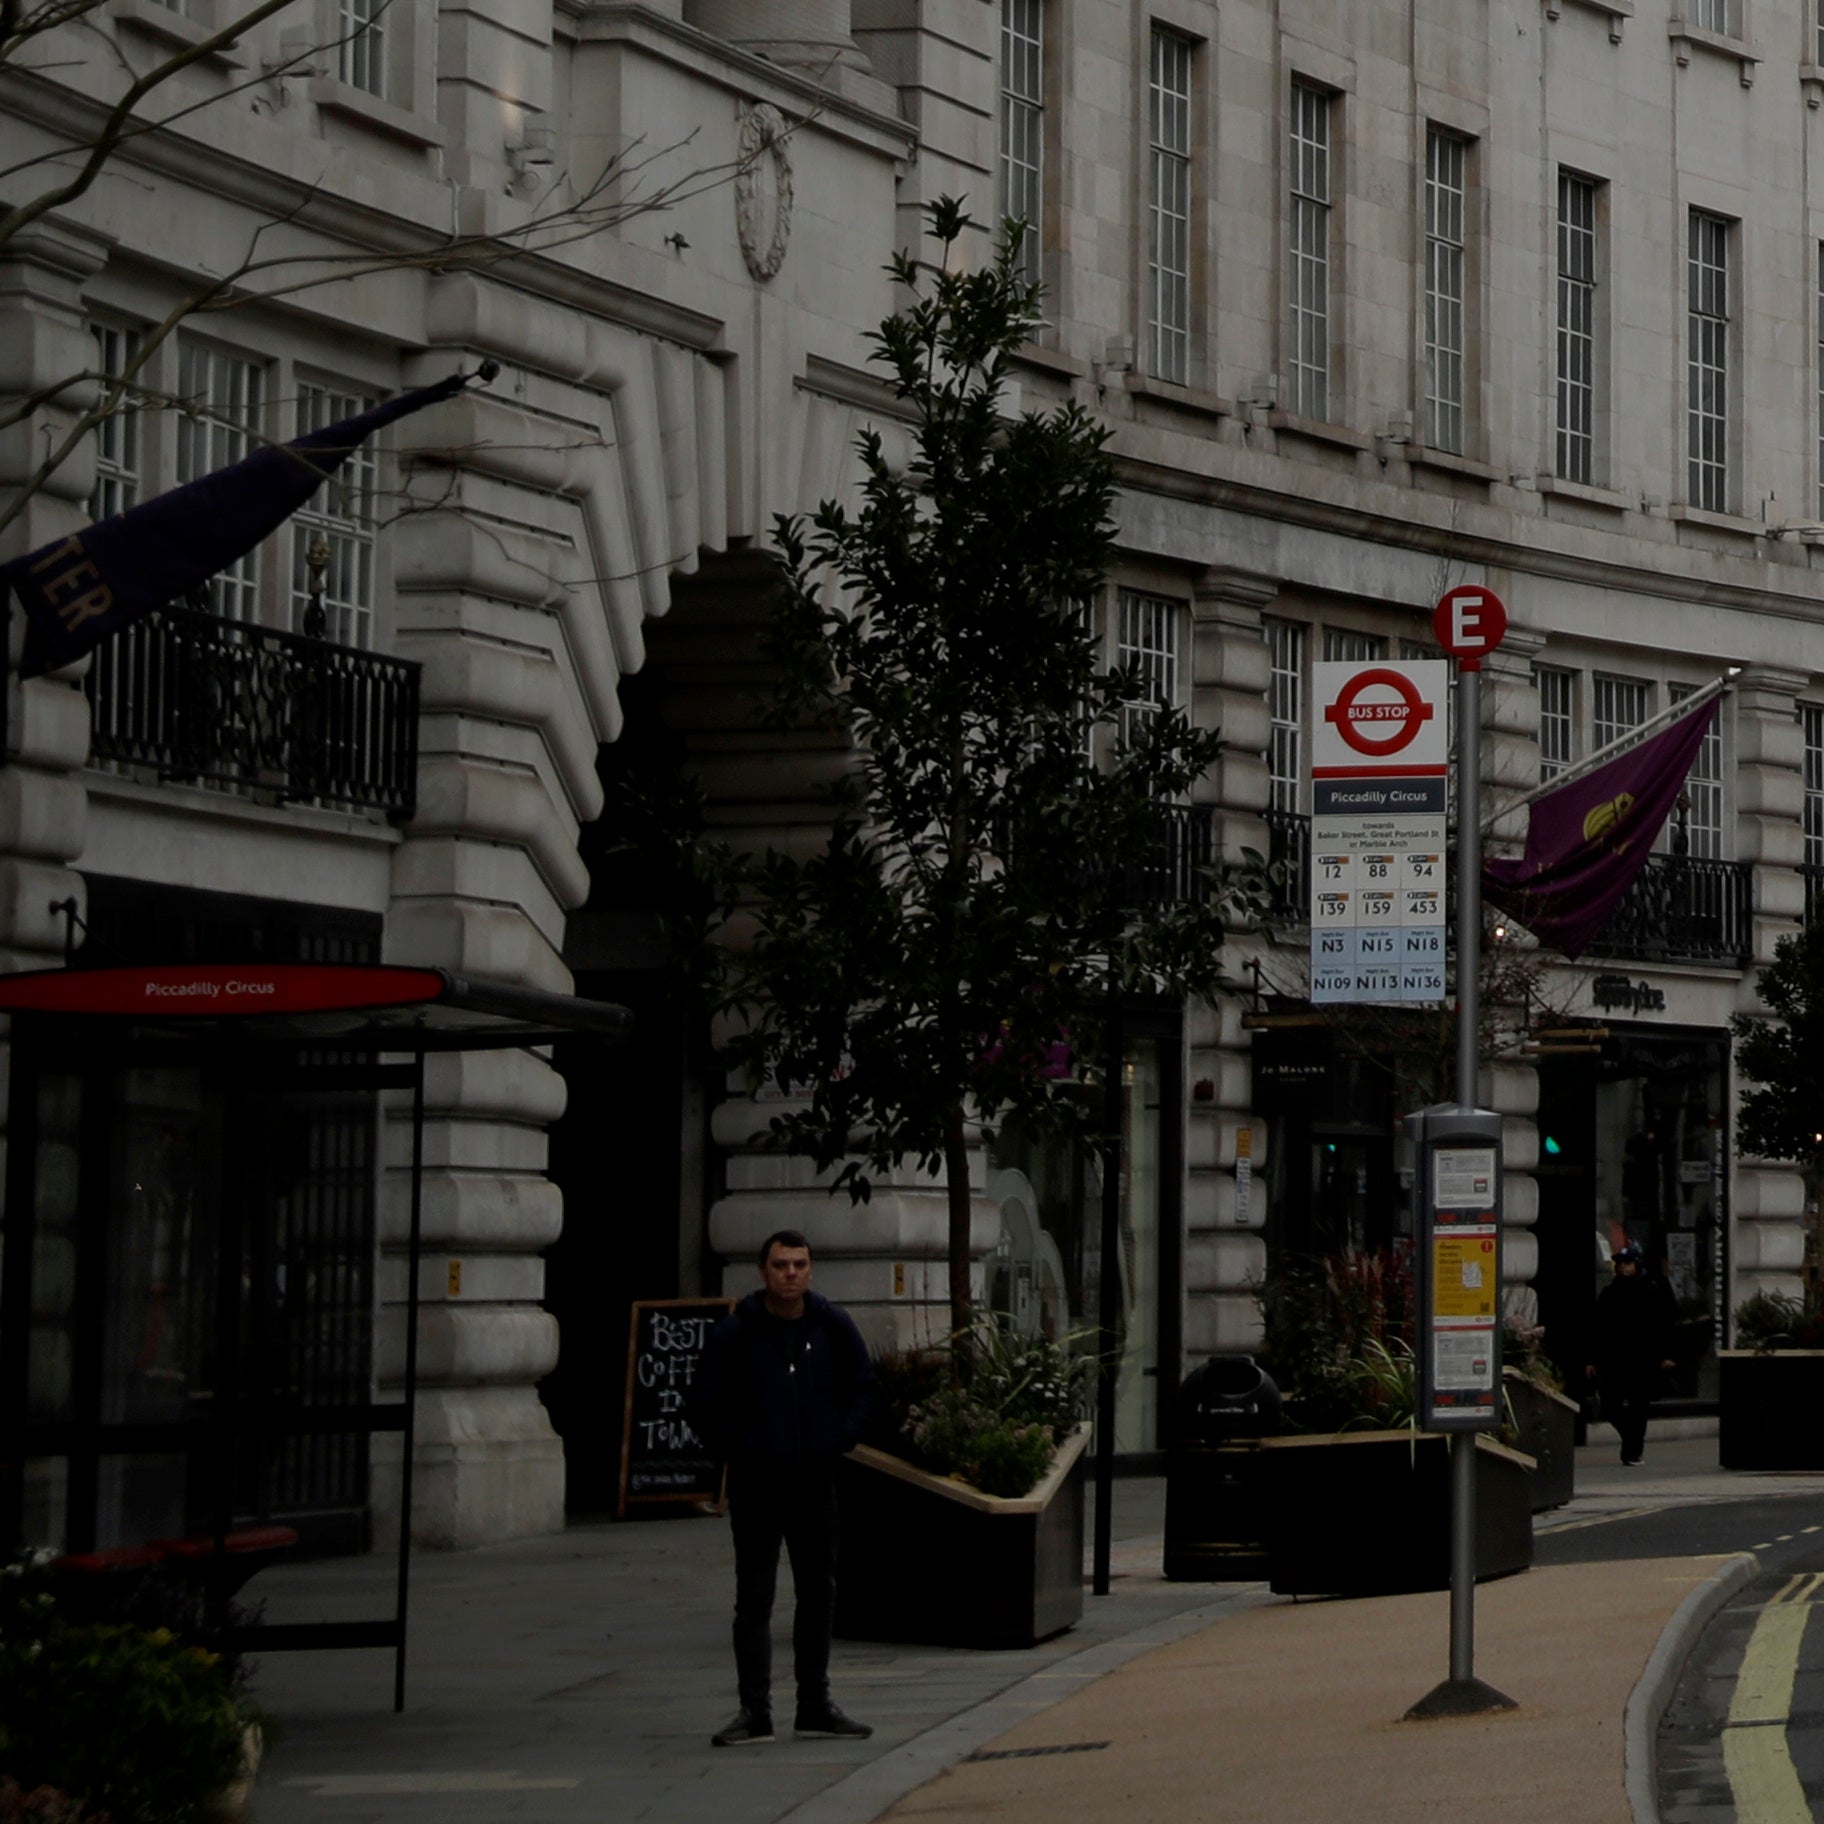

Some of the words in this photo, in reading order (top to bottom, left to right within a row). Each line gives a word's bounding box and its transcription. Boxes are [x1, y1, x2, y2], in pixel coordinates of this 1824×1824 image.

[1451, 596, 1486, 648] E
[1347, 706, 1373, 719] BUS
[1376, 705, 1410, 719] STOP
[1330, 790, 1387, 805] Piccadilly
[1389, 790, 1428, 802] Circus
[1317, 831, 1340, 839] Baker
[1370, 830, 1393, 838] Great
[1394, 829, 1430, 838] Portland
[1359, 840, 1387, 848] Marble
[1389, 839, 1409, 847] Arch
[1325, 865, 1342, 878] 12
[1369, 864, 1388, 877] 88
[1413, 864, 1432, 877] 94
[1320, 902, 1346, 915] 139
[1365, 901, 1391, 915] 159
[1409, 900, 1437, 914] 453
[1322, 939, 1344, 953] N3
[1362, 939, 1393, 952] N15
[1407, 937, 1438, 951] N18
[144, 981, 221, 998] Piccadilly
[224, 980, 275, 995] Circus
[1314, 977, 1351, 990] N109
[1357, 975, 1398, 989] N113
[1404, 976, 1441, 989] N136
[1713, 1224, 1724, 1352] SUPERDRY
